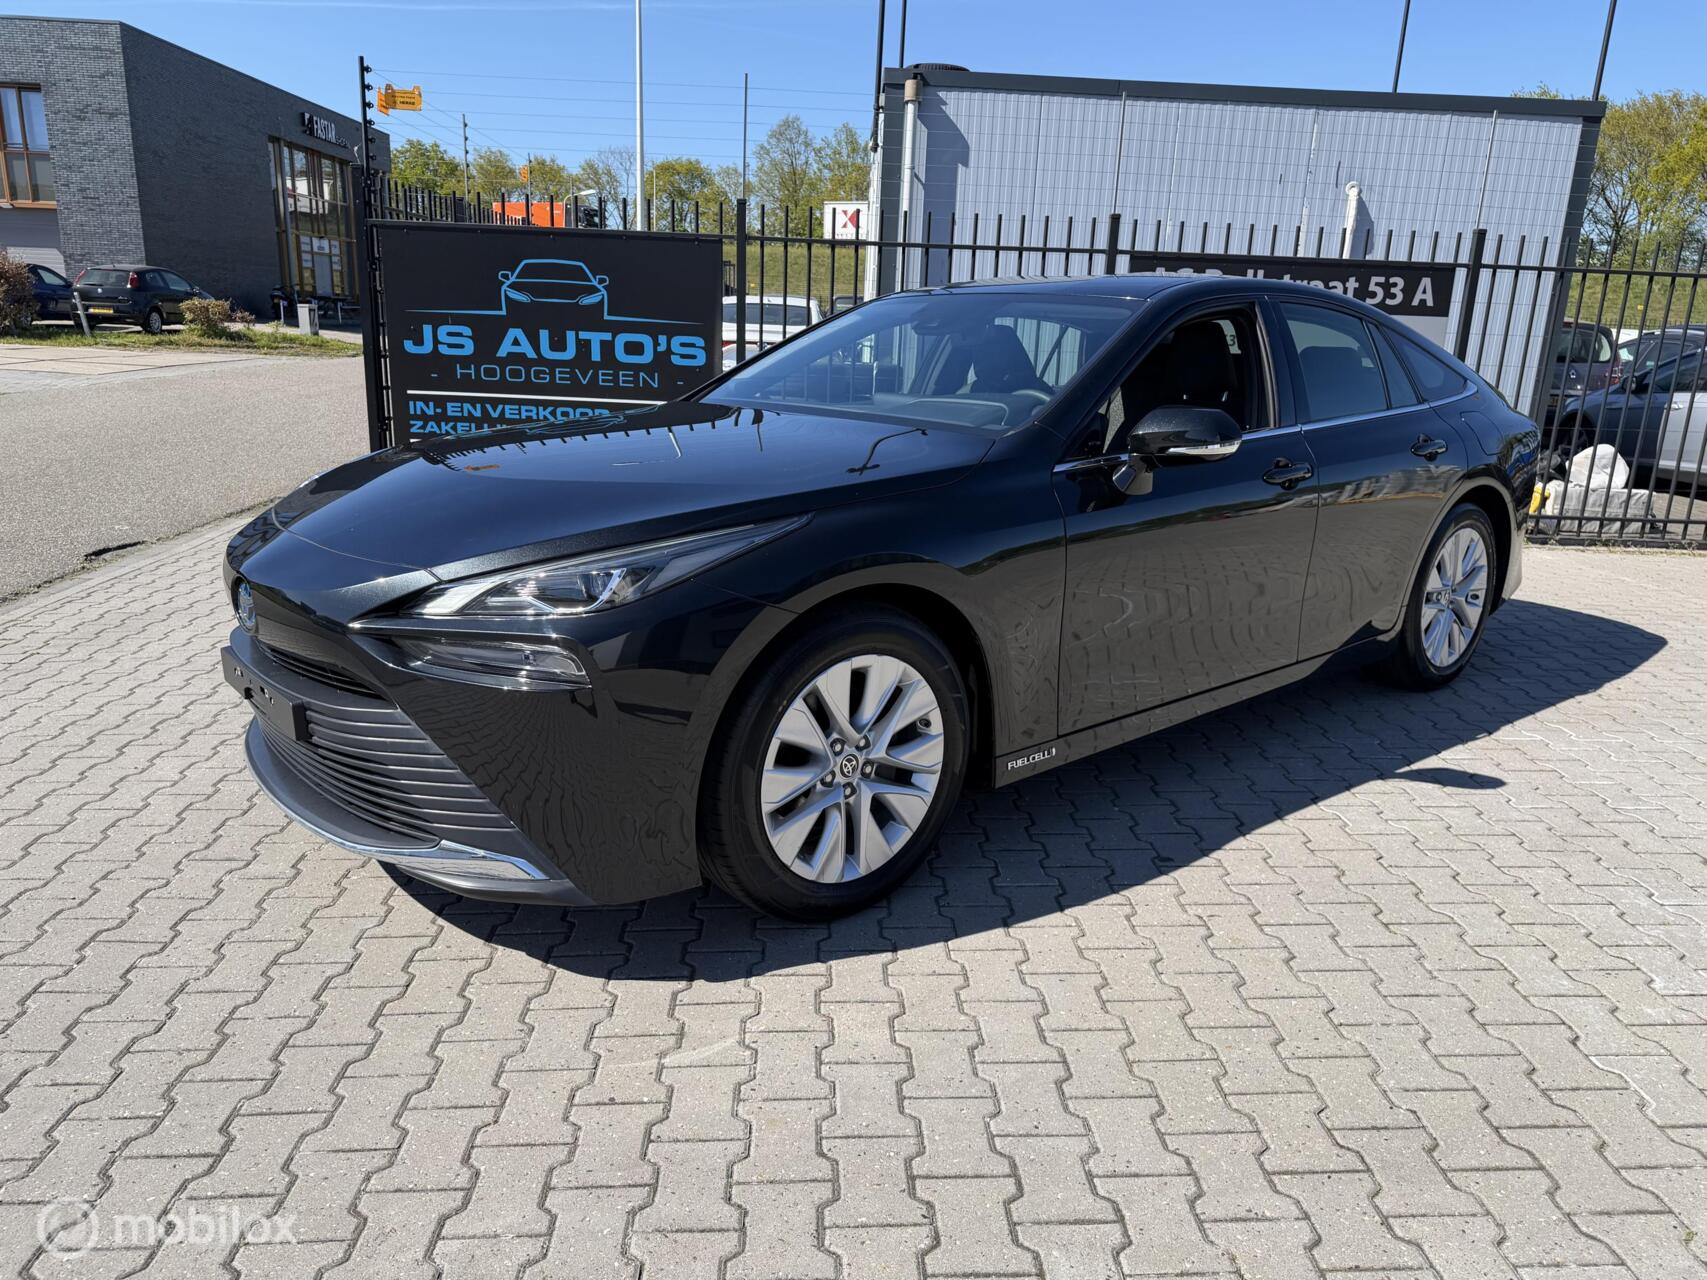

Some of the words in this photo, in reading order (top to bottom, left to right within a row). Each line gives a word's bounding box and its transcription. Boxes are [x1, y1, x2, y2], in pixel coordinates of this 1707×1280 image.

[1365, 276, 1404, 306] 53
[1411, 277, 1434, 307] A
[403, 324, 475, 356] JS
[495, 327, 708, 367] AUTO'S
[456, 363, 660, 388] HOOGEVEEN
[409, 401, 442, 415] IN-
[446, 402, 482, 417] EN
